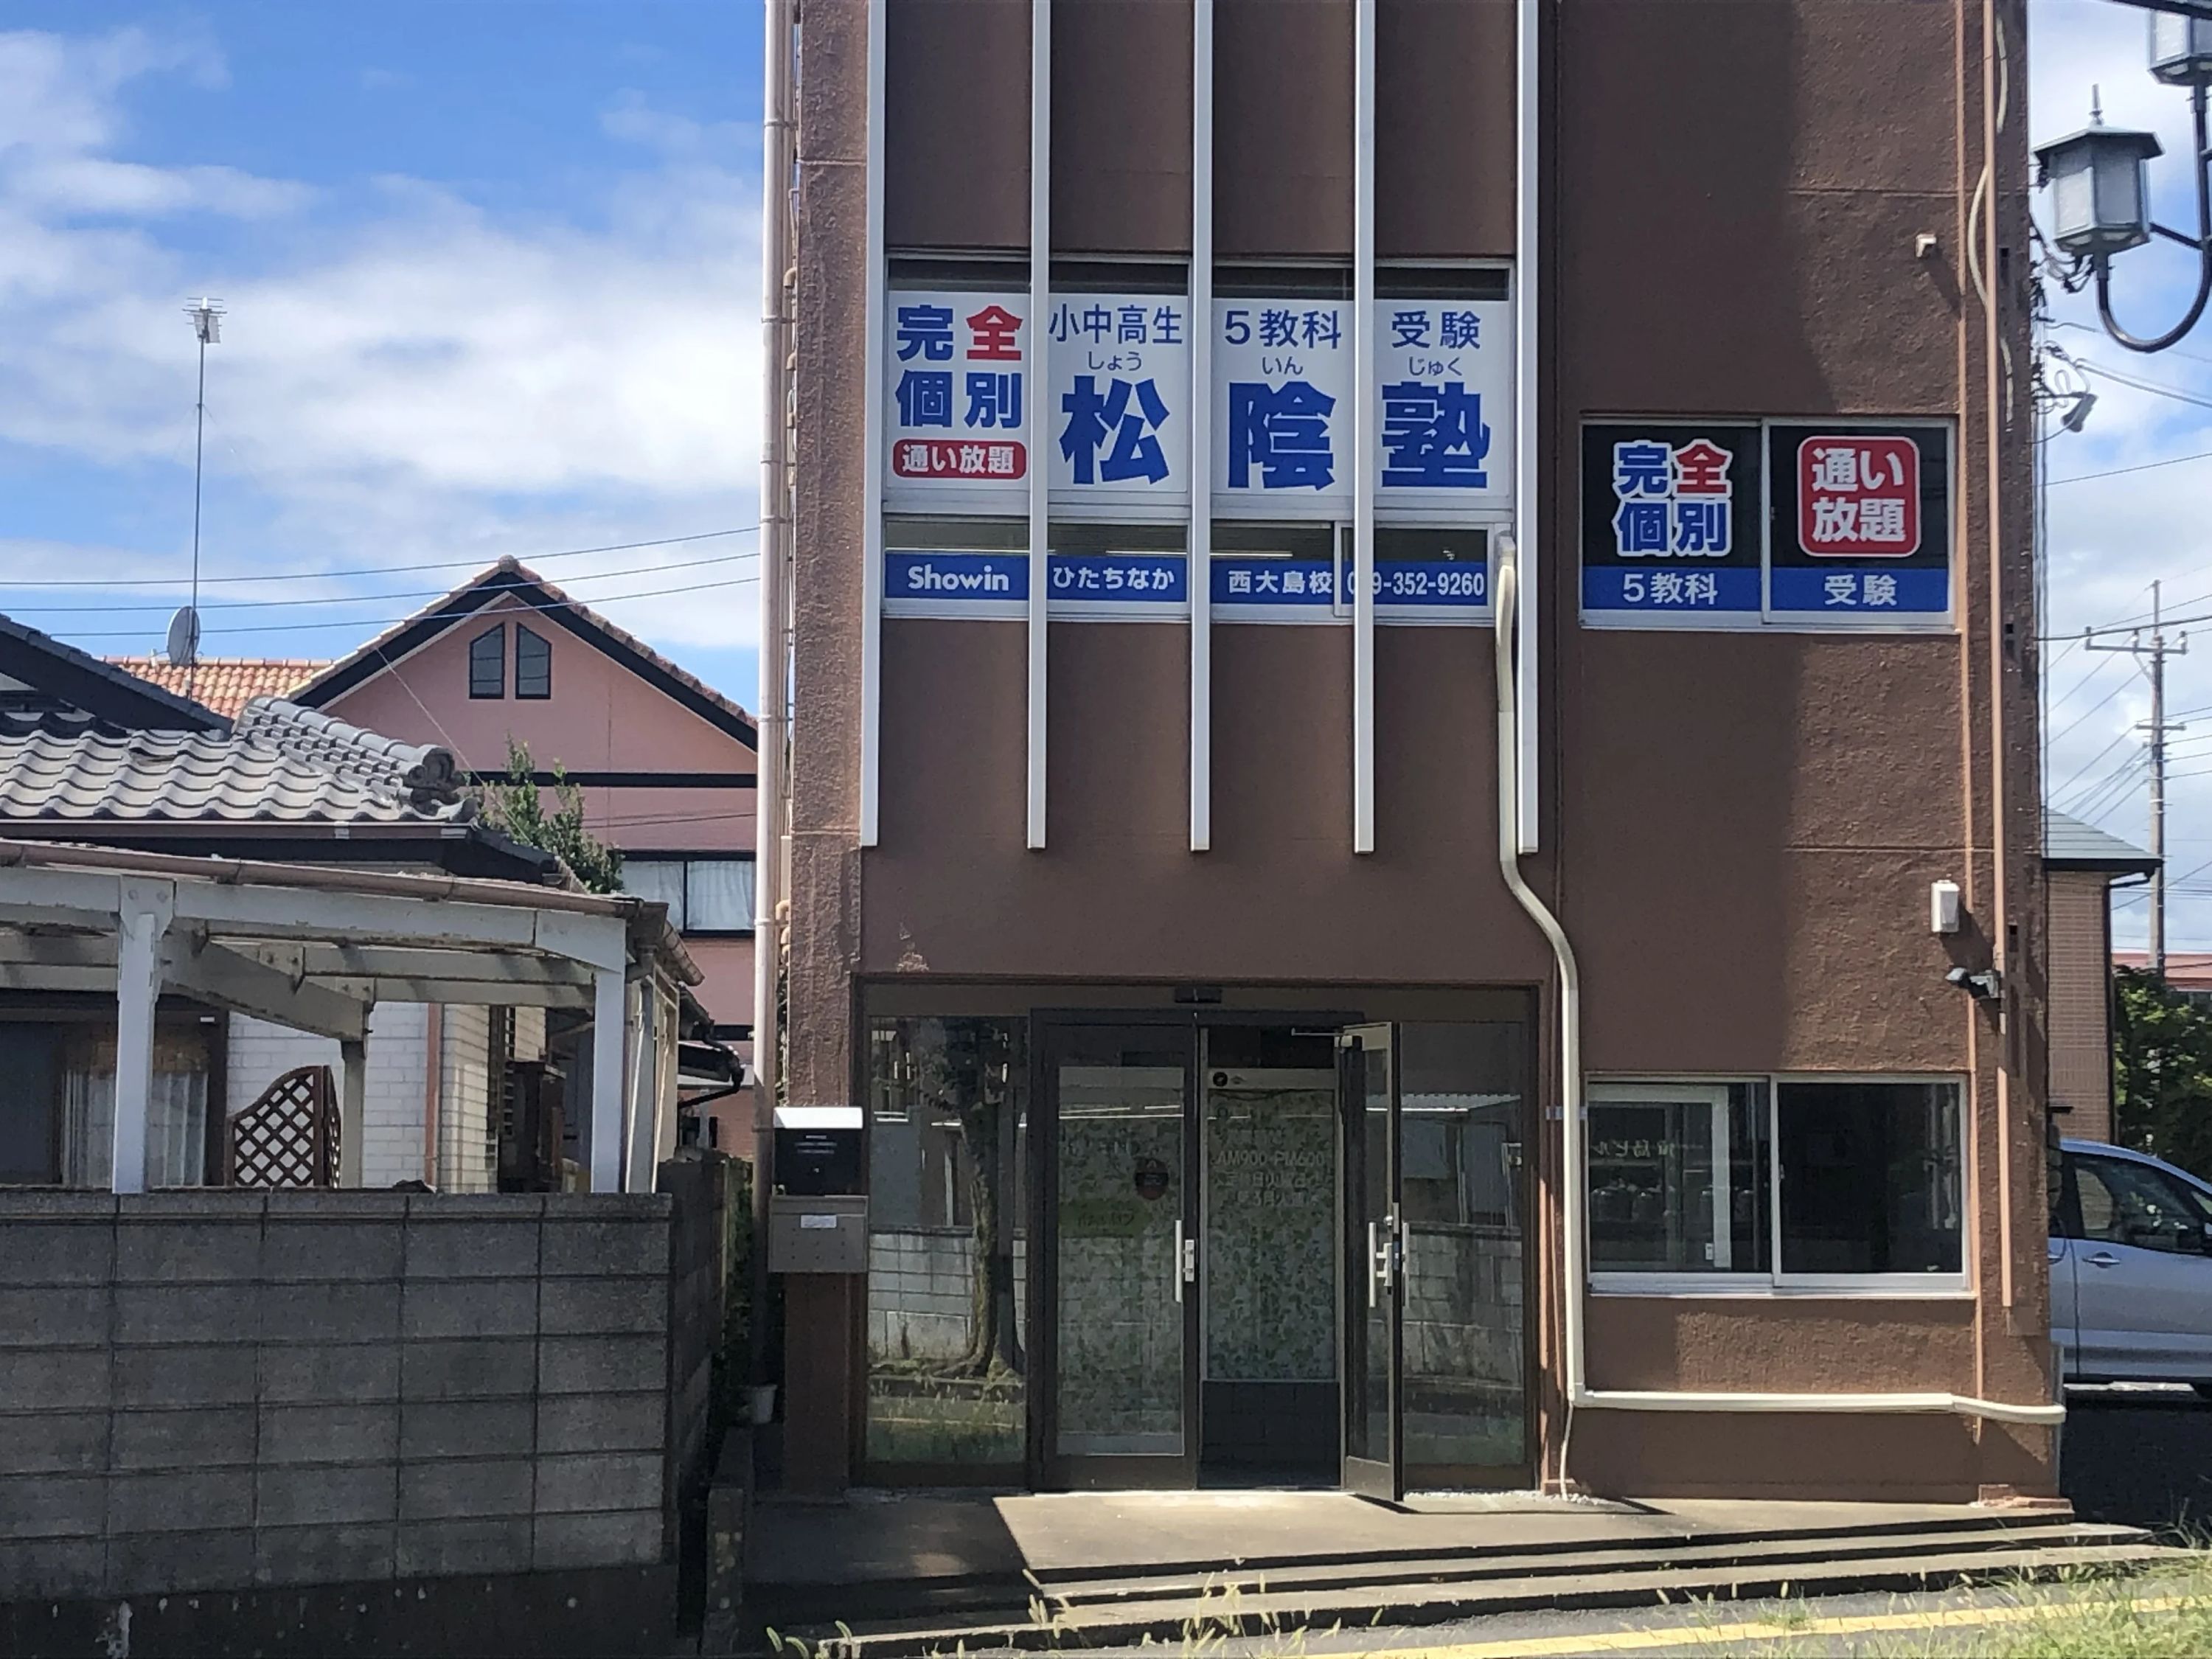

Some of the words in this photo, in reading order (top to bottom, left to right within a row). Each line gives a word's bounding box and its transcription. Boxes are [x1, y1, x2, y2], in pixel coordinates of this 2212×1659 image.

[897, 305, 1023, 361] 完全
[1048, 303, 1183, 344] 小中高生
[1225, 308, 1341, 349] 5教科
[1391, 310, 1481, 349] 受験
[1088, 351, 1143, 371] しょう
[1262, 356, 1304, 375] いん
[1408, 356, 1463, 376] じゅく
[895, 369, 1023, 428] 個別
[902, 444, 1015, 474] 通い放題
[1615, 439, 1732, 497] 完全
[1812, 447, 1905, 493] 通い
[1613, 499, 1731, 556] 個別
[1812, 497, 1906, 543] 放題
[908, 563, 1009, 591] Showin
[1053, 566, 1175, 591] ひたちなか
[1228, 570, 1333, 594] 西大島校
[1346, 571, 1484, 597] 09-352-9260
[1623, 572, 1719, 605] 5教科
[1823, 574, 1898, 607] 受験
